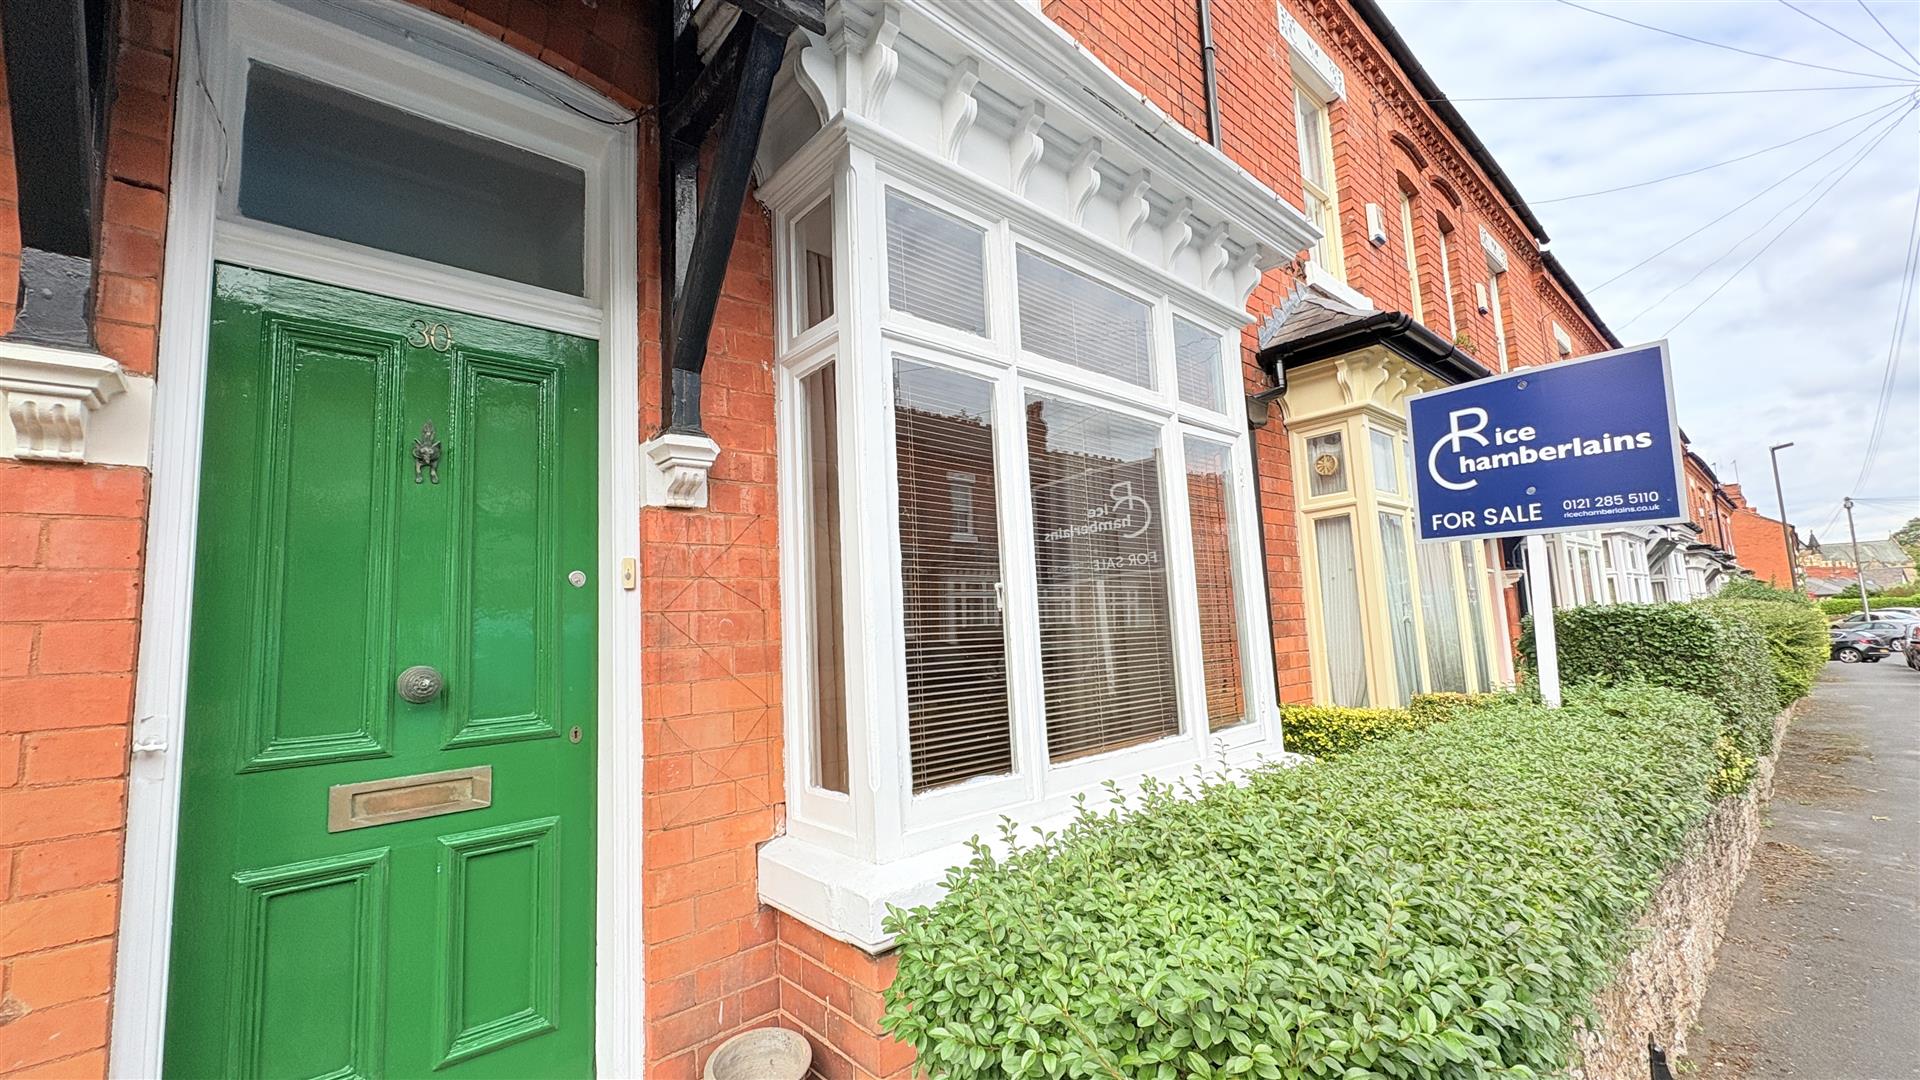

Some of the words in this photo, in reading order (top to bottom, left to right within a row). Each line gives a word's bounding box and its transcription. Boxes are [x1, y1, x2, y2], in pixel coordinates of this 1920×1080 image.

[408, 320, 451, 353] 30
[1449, 407, 1536, 453] Rice
[1428, 431, 1652, 490] Chamberlains
[1563, 499, 1590, 510] 0121
[1595, 495, 1624, 507] 285
[1628, 491, 1659, 504] 5110
[1564, 504, 1660, 518] ricechamberlains.co.uk
[1432, 511, 1476, 531] FOR
[1484, 503, 1542, 526] SALE
